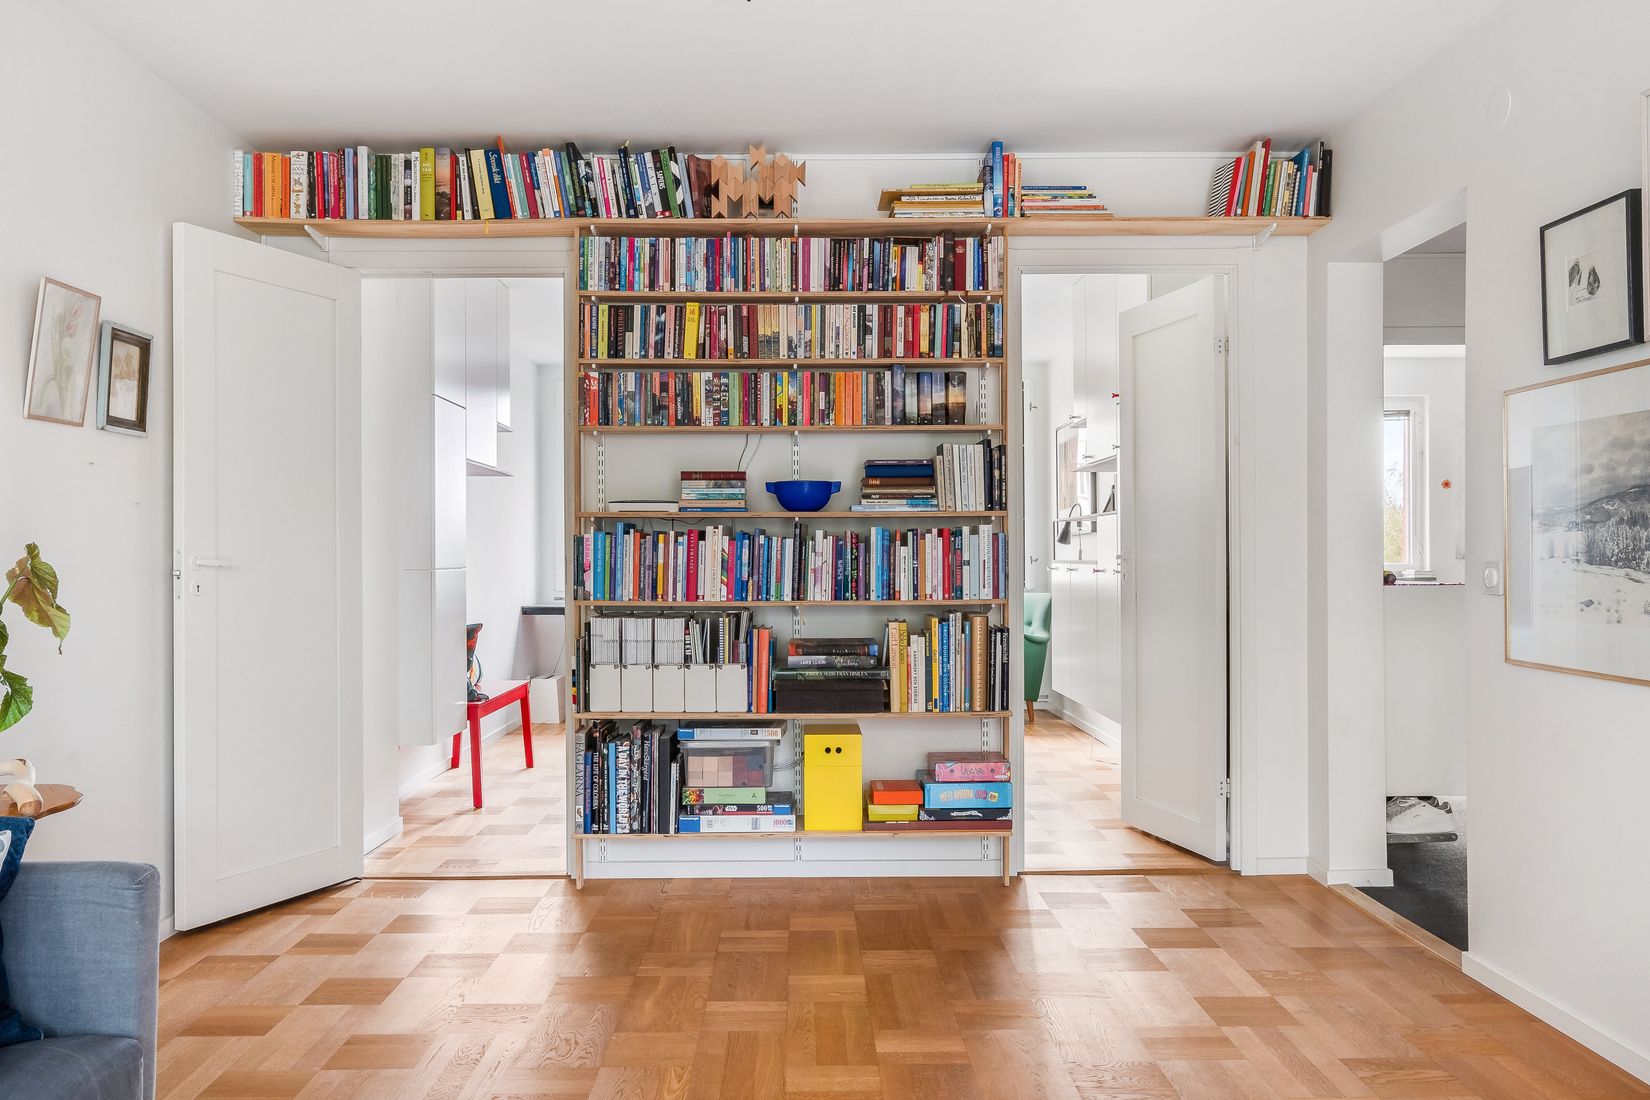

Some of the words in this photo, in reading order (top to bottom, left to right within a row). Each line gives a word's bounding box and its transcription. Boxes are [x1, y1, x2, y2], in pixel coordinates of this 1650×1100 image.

[656, 170, 665, 190] SAPIENS
[618, 752, 630, 768] DAY
[575, 741, 585, 797] FÅGLARNA
[618, 769, 630, 778] IN
[617, 778, 630, 794] THE
[617, 795, 630, 823] WORLD
[773, 818, 787, 826] 1000
